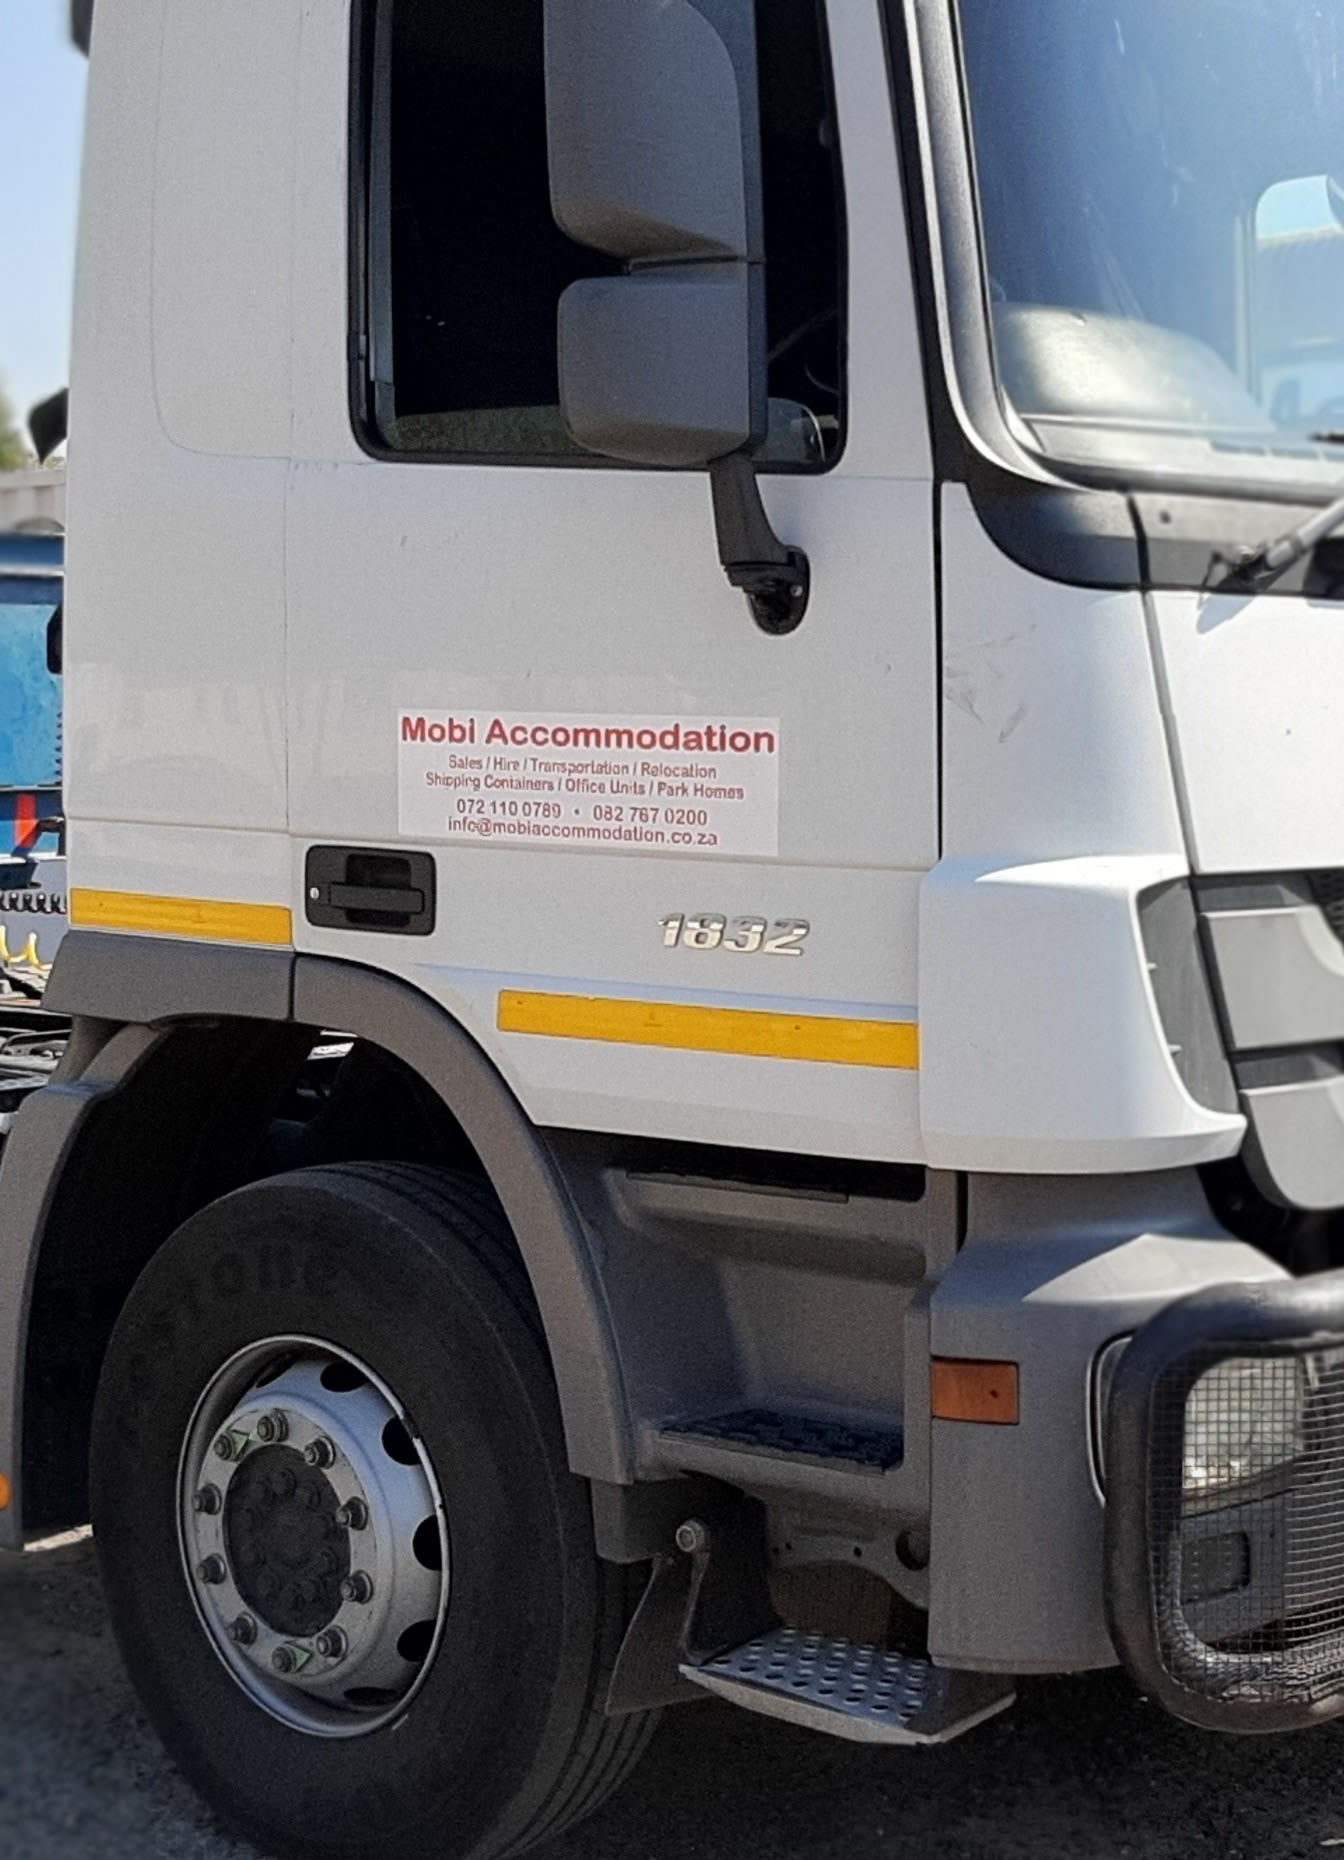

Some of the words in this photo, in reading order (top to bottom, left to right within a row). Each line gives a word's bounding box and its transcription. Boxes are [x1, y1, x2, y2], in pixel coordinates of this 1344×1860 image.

[401, 716, 475, 745] Mobi
[485, 718, 775, 753] Accommodation
[448, 755, 483, 770] Sales
[493, 756, 520, 772] Hire
[530, 758, 629, 777] Transportation
[640, 762, 717, 779] Relocation
[426, 772, 481, 791] Shipping
[484, 774, 554, 791] Containers
[565, 778, 606, 795] Office
[609, 780, 646, 796] Units
[657, 782, 690, 798] Park
[693, 784, 745, 800] Homes
[456, 799, 485, 815] 072
[490, 800, 518, 817] 110
[593, 805, 624, 822] 082
[664, 808, 708, 826] 0200
[448, 816, 718, 846] info@mobiaccommodation.co.za
[657, 913, 811, 956] 1832
